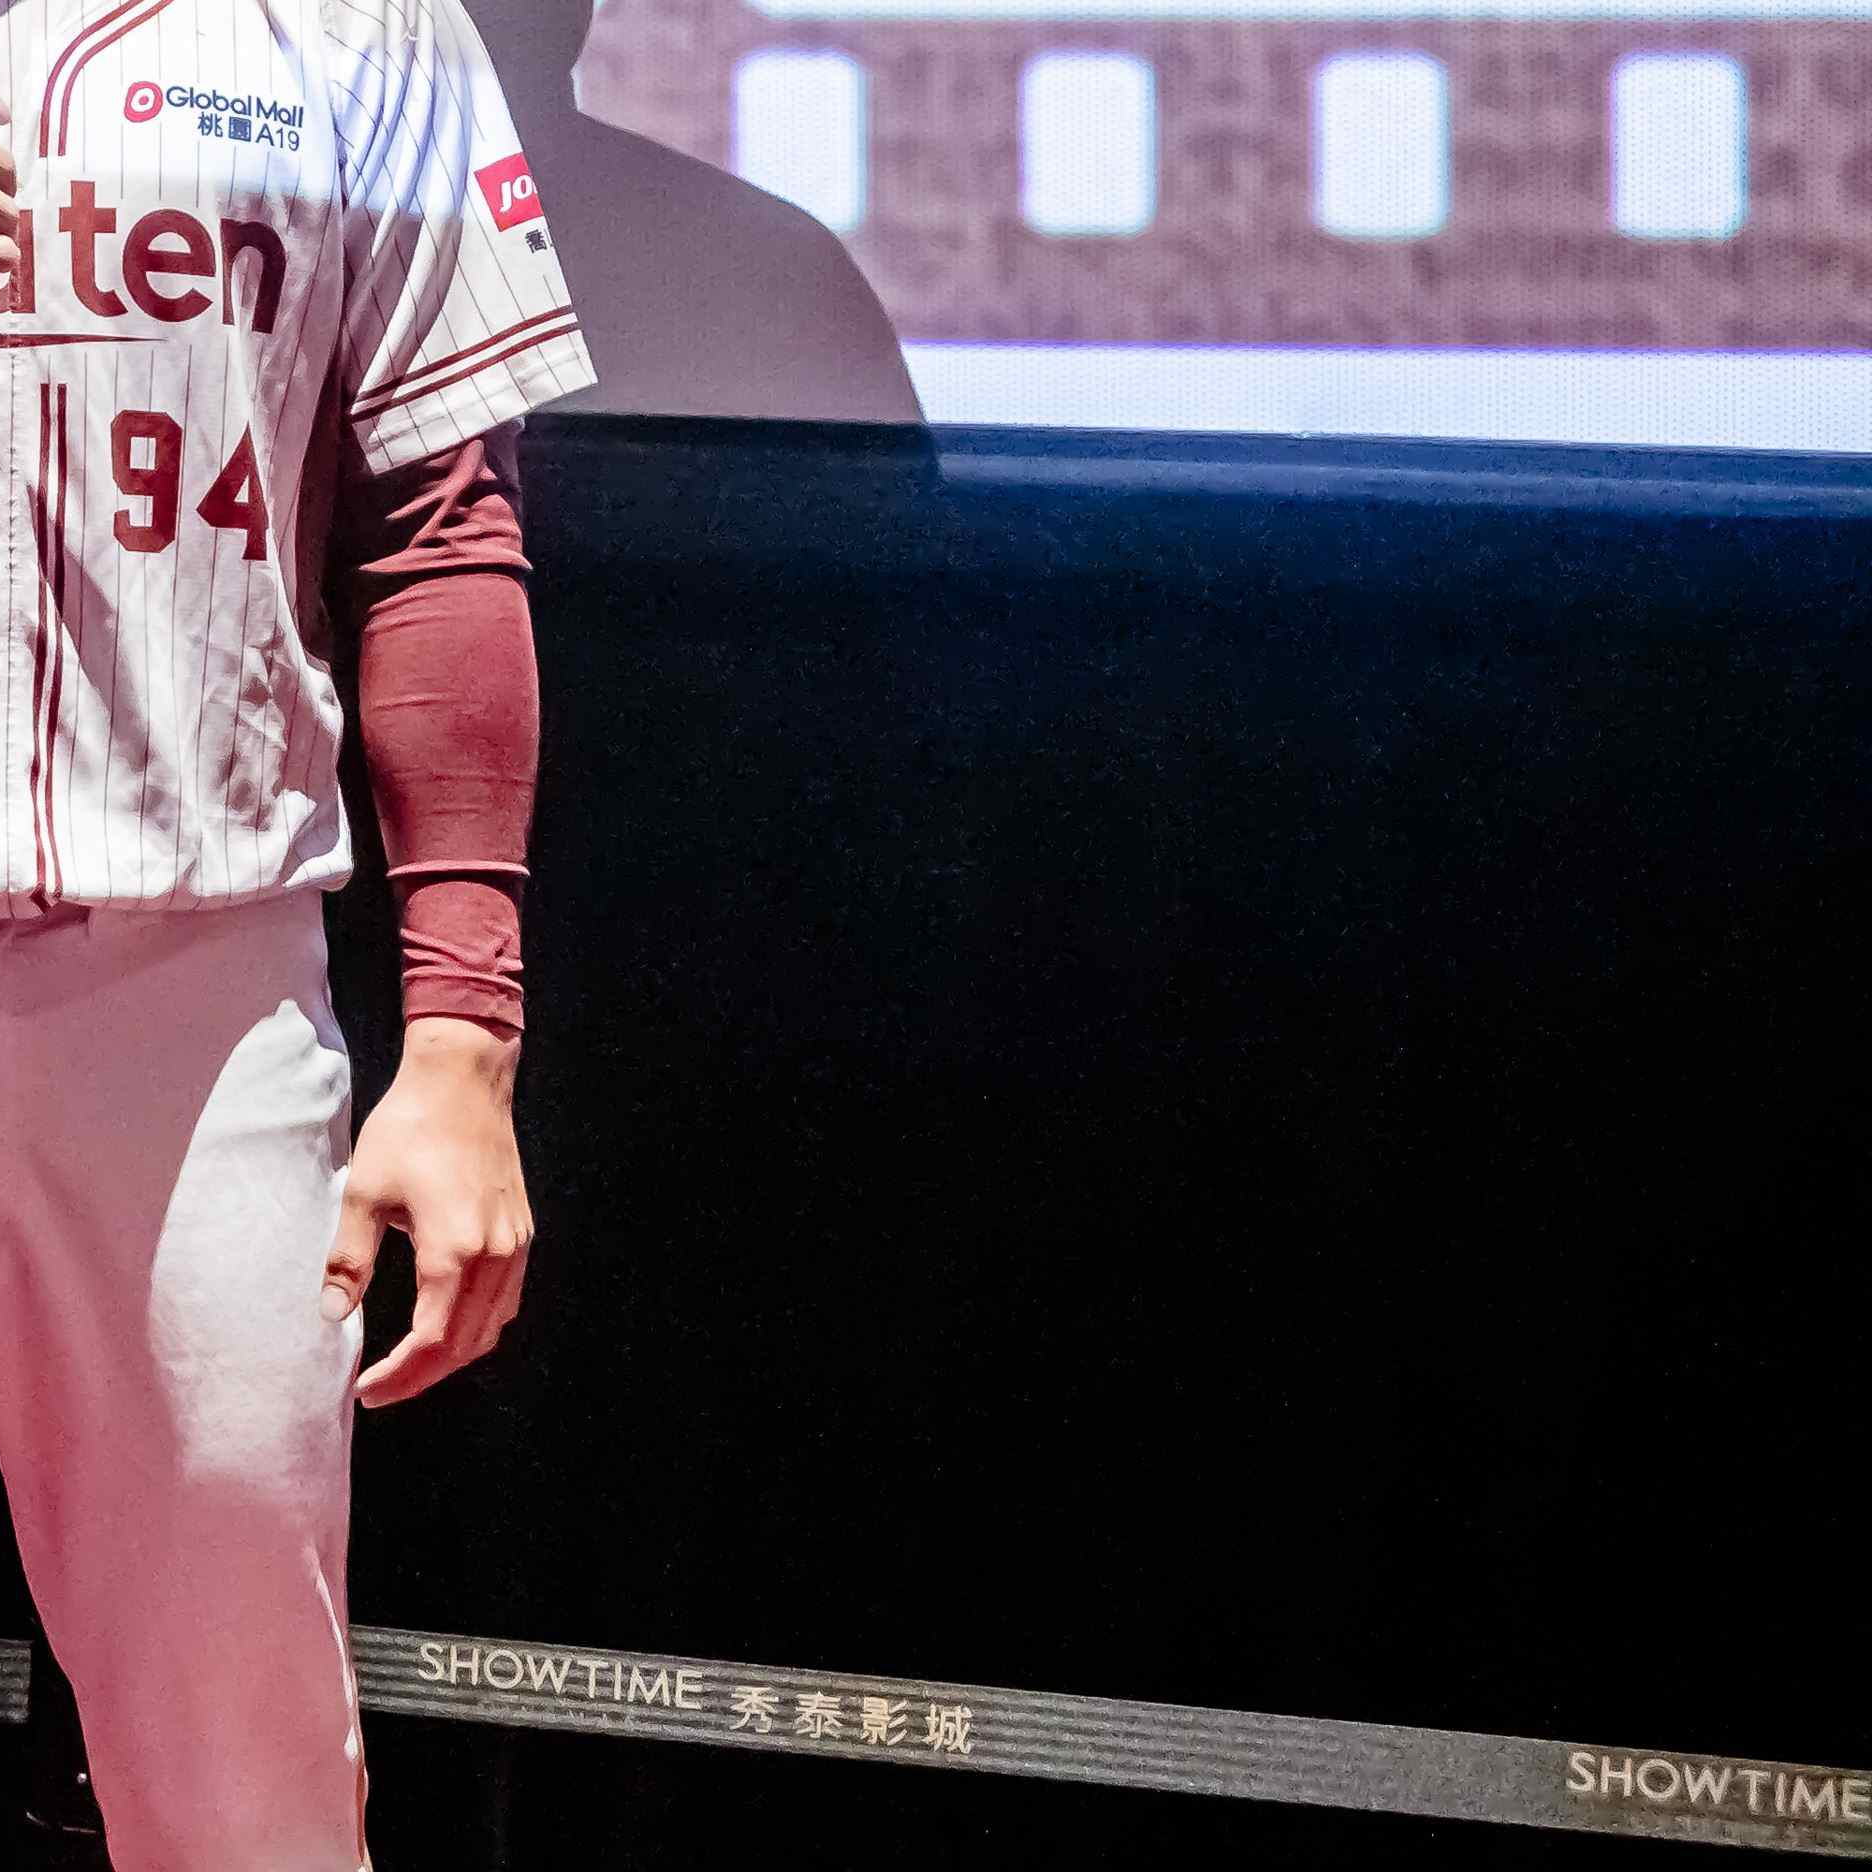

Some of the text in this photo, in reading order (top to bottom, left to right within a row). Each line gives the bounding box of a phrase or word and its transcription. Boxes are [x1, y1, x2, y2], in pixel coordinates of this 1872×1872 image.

[166, 86, 304, 129] Global Mall
[499, 174, 539, 215] JO
[110, 409, 270, 562] 94
[418, 1641, 704, 1710] SHOWTIME
[730, 1685, 973, 1755] 秀泰影城
[1567, 1751, 1872, 1822] SHOWTIME
